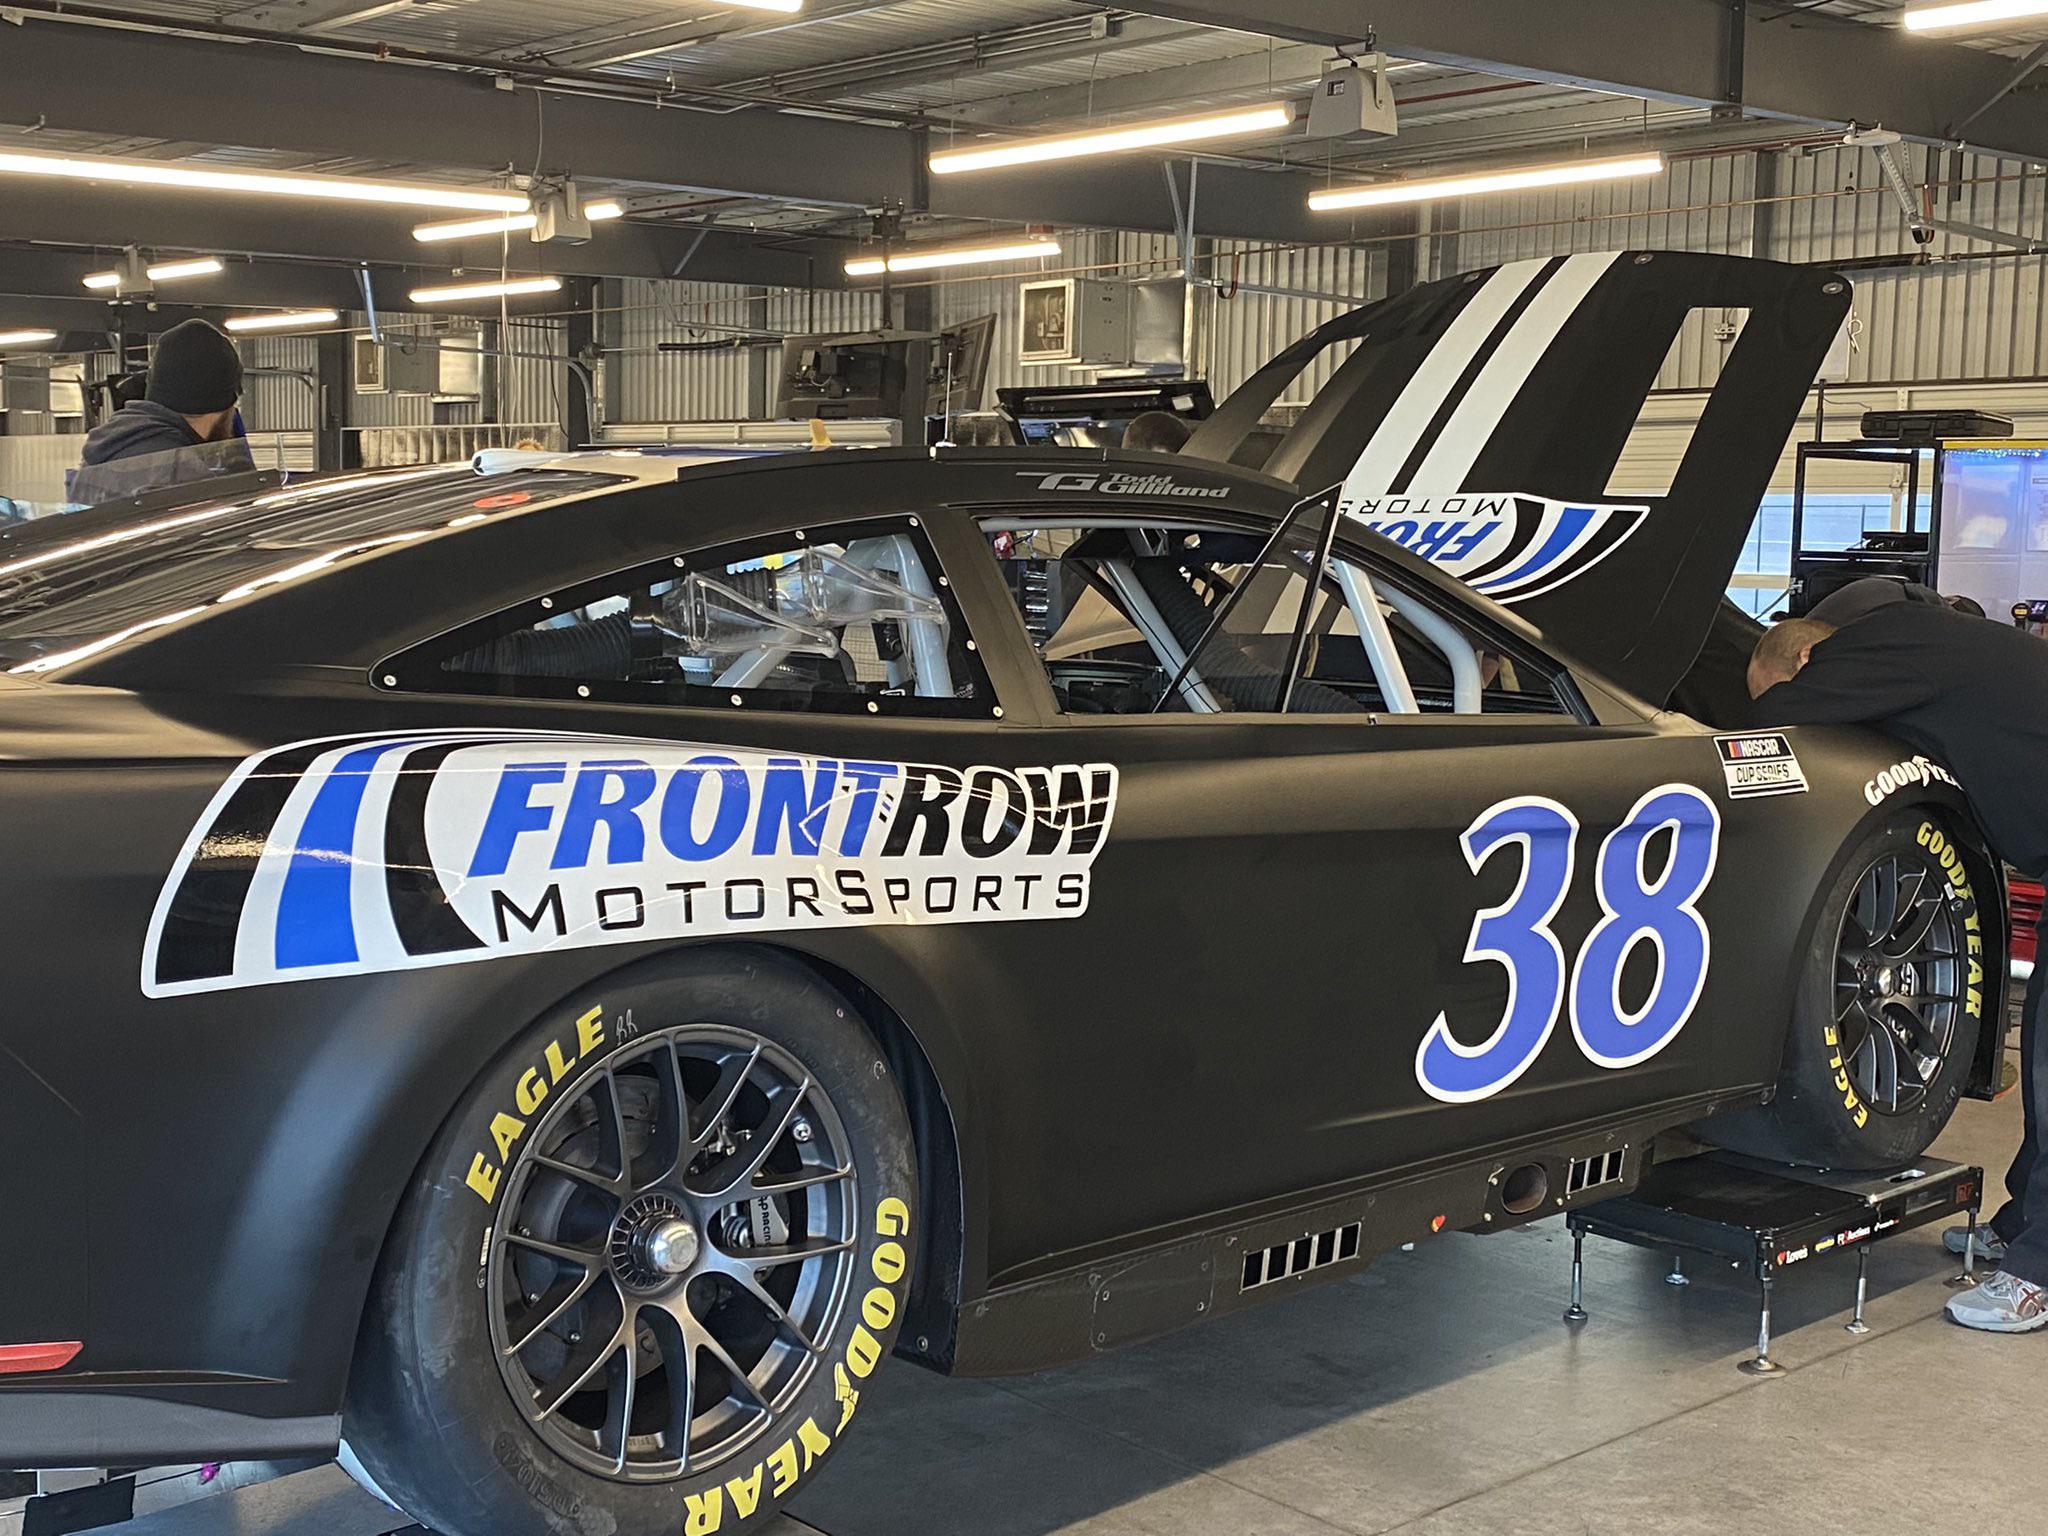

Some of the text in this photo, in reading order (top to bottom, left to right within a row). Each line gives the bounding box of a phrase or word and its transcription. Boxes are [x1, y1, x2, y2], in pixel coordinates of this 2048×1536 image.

[1099, 481, 1230, 498] Gilliland
[1109, 473, 1173, 484] Todd
[1340, 498, 1507, 517] MOTORS
[1367, 520, 1503, 561] FRO
[1741, 739, 1780, 757] NASCAR
[1736, 767, 1755, 783] CUP
[497, 869, 1083, 943] MOTORSPORTS
[1415, 783, 1721, 1104] 38
[1824, 1026, 1868, 1129] EAGLE
[465, 1005, 605, 1204] EAGLE
